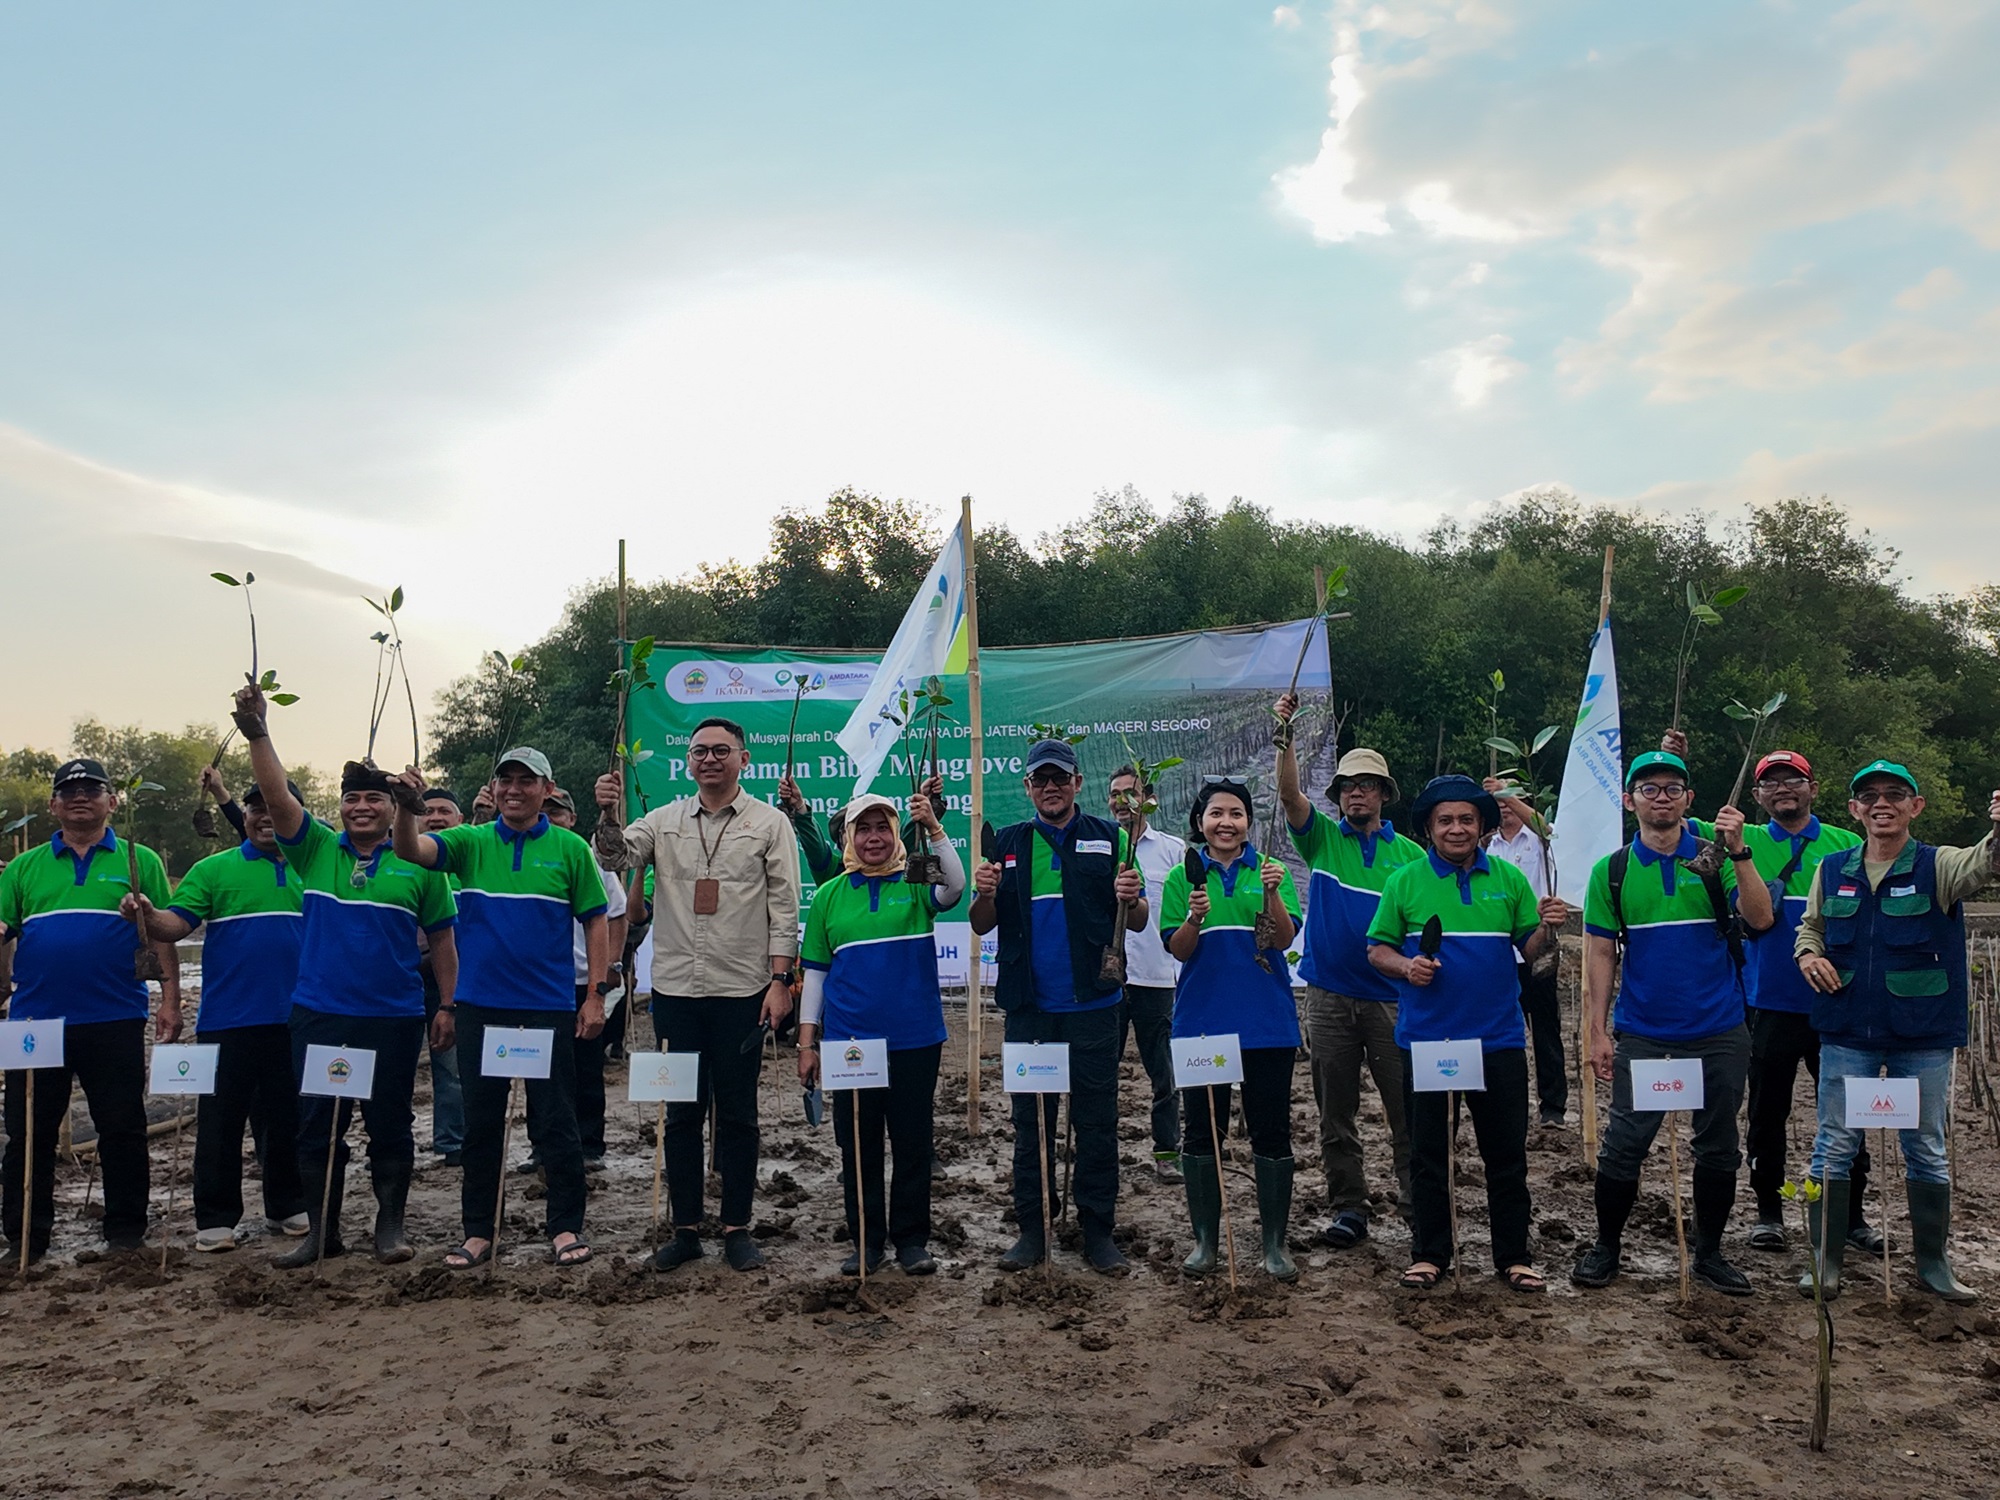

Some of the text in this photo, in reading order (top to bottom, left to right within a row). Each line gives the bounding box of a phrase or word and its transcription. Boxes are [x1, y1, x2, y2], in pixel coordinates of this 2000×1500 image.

[985, 725, 1038, 738] JATENG
[1067, 725, 1090, 735] dan
[1094, 722, 1147, 734] MAGERI
[1151, 718, 1211, 732] SEGORO
[889, 753, 1022, 782] Mangrove
[1575, 745, 1589, 761] AIR
[1585, 758, 1610, 791] DALAM
[1186, 1056, 1213, 1068] Ades
[1652, 1080, 1671, 1092] dbs
